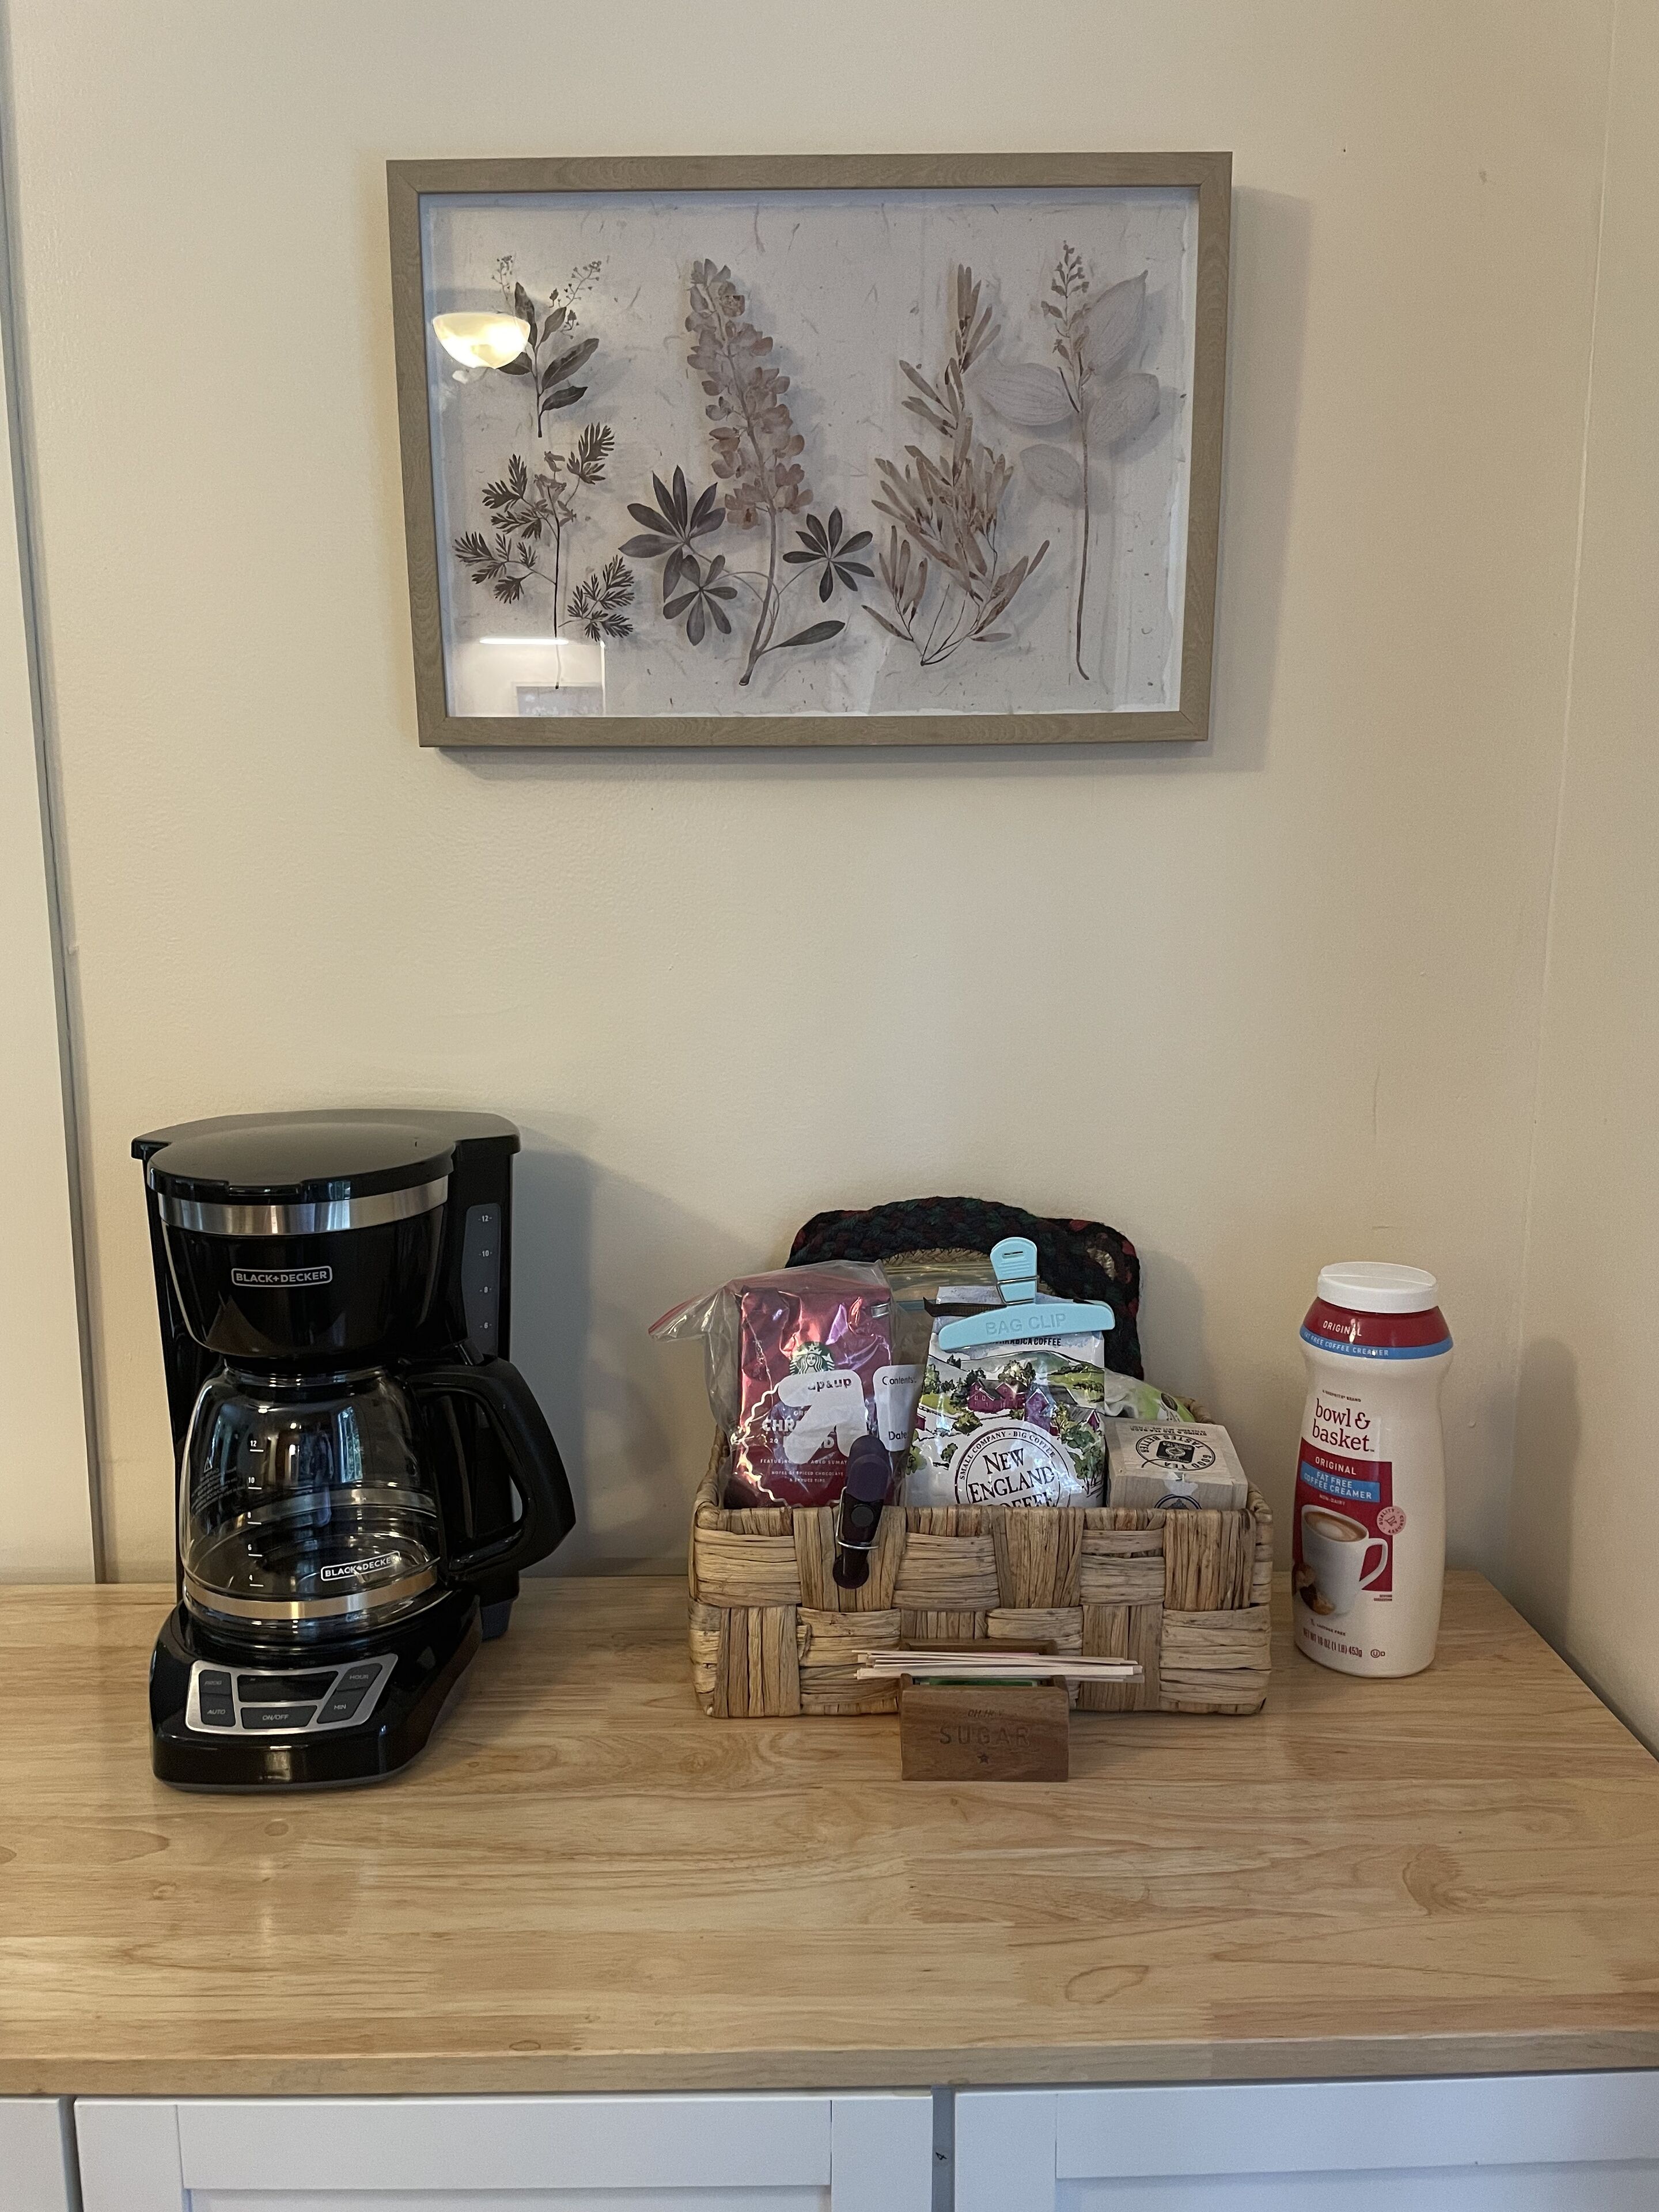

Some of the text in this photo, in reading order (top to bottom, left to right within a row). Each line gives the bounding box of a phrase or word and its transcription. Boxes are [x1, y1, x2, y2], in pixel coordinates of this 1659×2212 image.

[236, 1271, 327, 1283] BLACK+DECKER
[986, 1313, 1066, 1335] BAG CLIP
[1323, 1320, 1362, 1336] ORIGINAL
[1033, 1338, 1062, 1346] COFFEE
[1310, 1335, 1324, 1346] FREE
[1325, 1340, 1350, 1353] COFFEE
[1316, 1397, 1370, 1429] bowl &
[1139, 1435, 1160, 1453] BETTER
[1163, 1435, 1203, 1449] TASTES
[959, 1453, 974, 1480] SMALL
[972, 1431, 1006, 1453] COMPANY
[1029, 1435, 1055, 1458] COFFEE
[982, 1448, 1024, 1475] NEW
[1191, 1455, 1212, 1468] GOOD
[1164, 1461, 1187, 1469] TEA
[1315, 1456, 1357, 1475] ORIGINAL
[968, 1466, 1055, 1503] ENGLAND
[1304, 1474, 1372, 1499] COFFEE CREAMER
[1317, 1471, 1353, 1488] FAT FREE
[1378, 1508, 1395, 1525] QUALITY
[325, 1555, 396, 1577] BLACK+DECKE
[1349, 1646, 1362, 1658] 453g
[940, 1726, 1031, 1747] SUGAR
